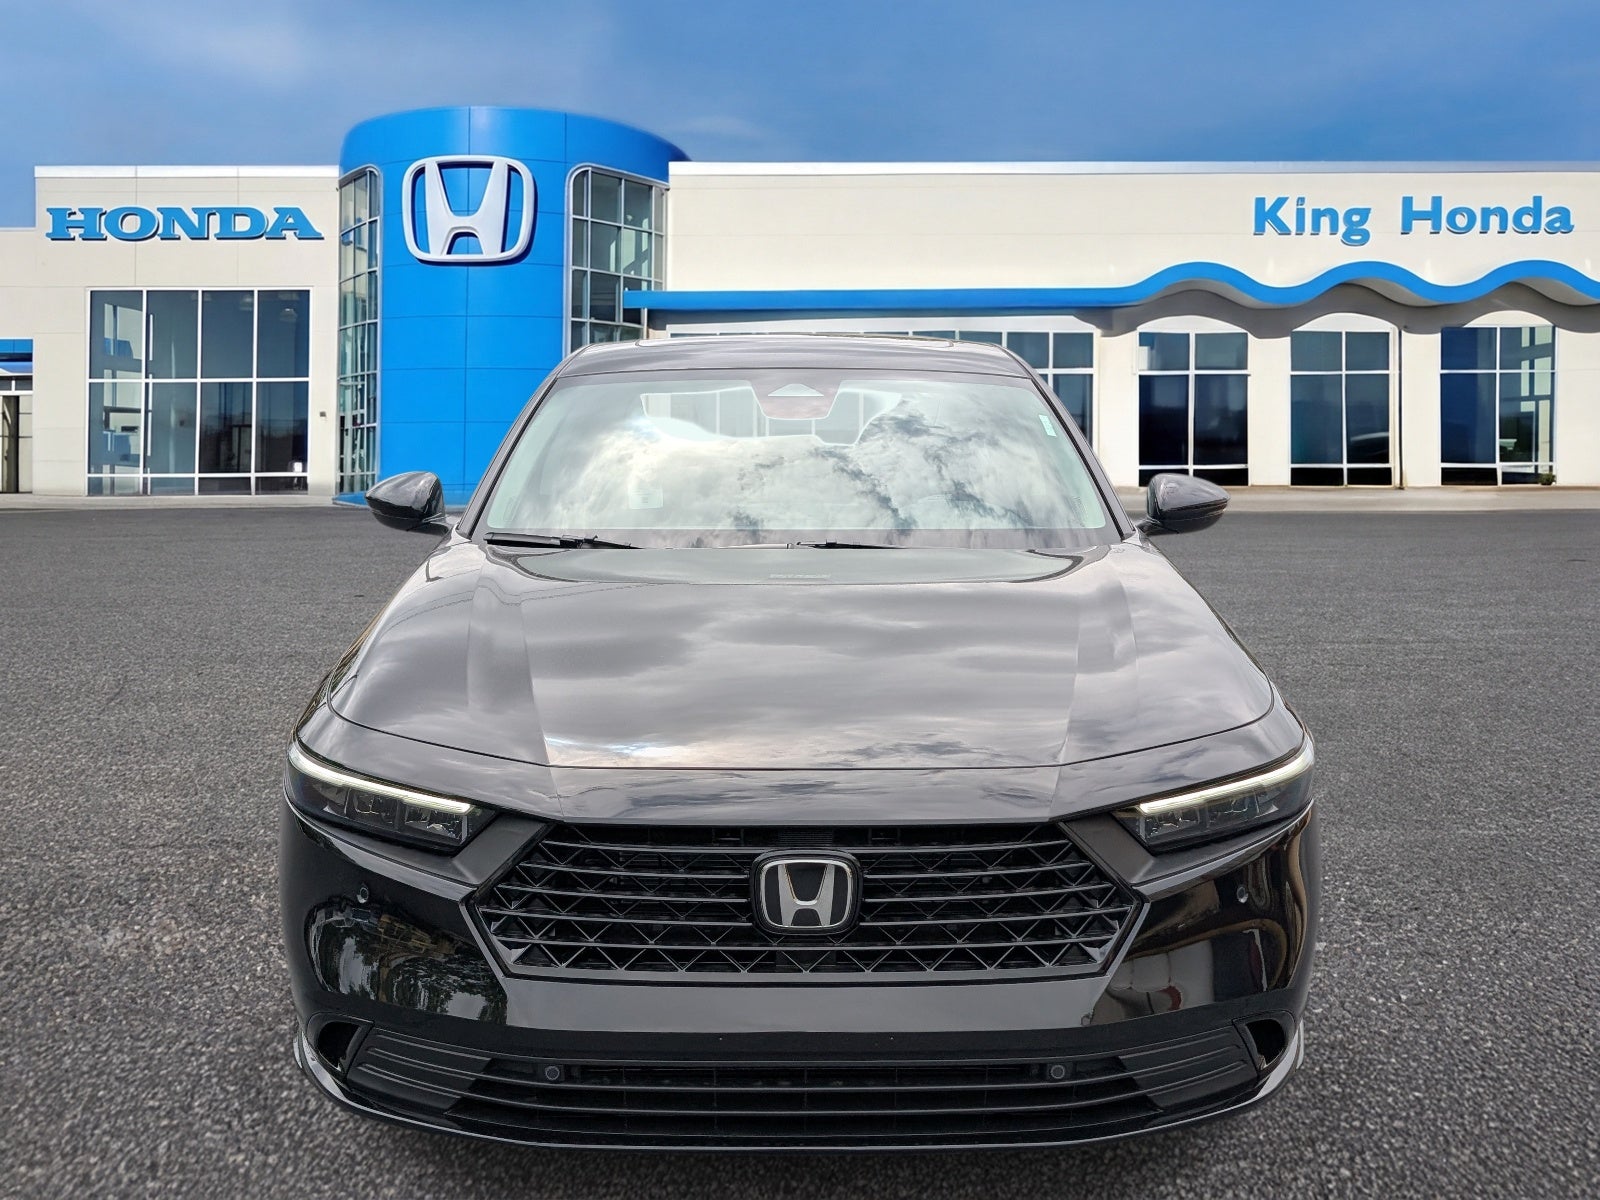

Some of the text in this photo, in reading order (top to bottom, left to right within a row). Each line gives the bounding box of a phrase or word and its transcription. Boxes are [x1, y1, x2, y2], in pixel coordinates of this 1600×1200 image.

[45, 206, 325, 241] HONDA
[1253, 195, 1575, 246] King Honda
